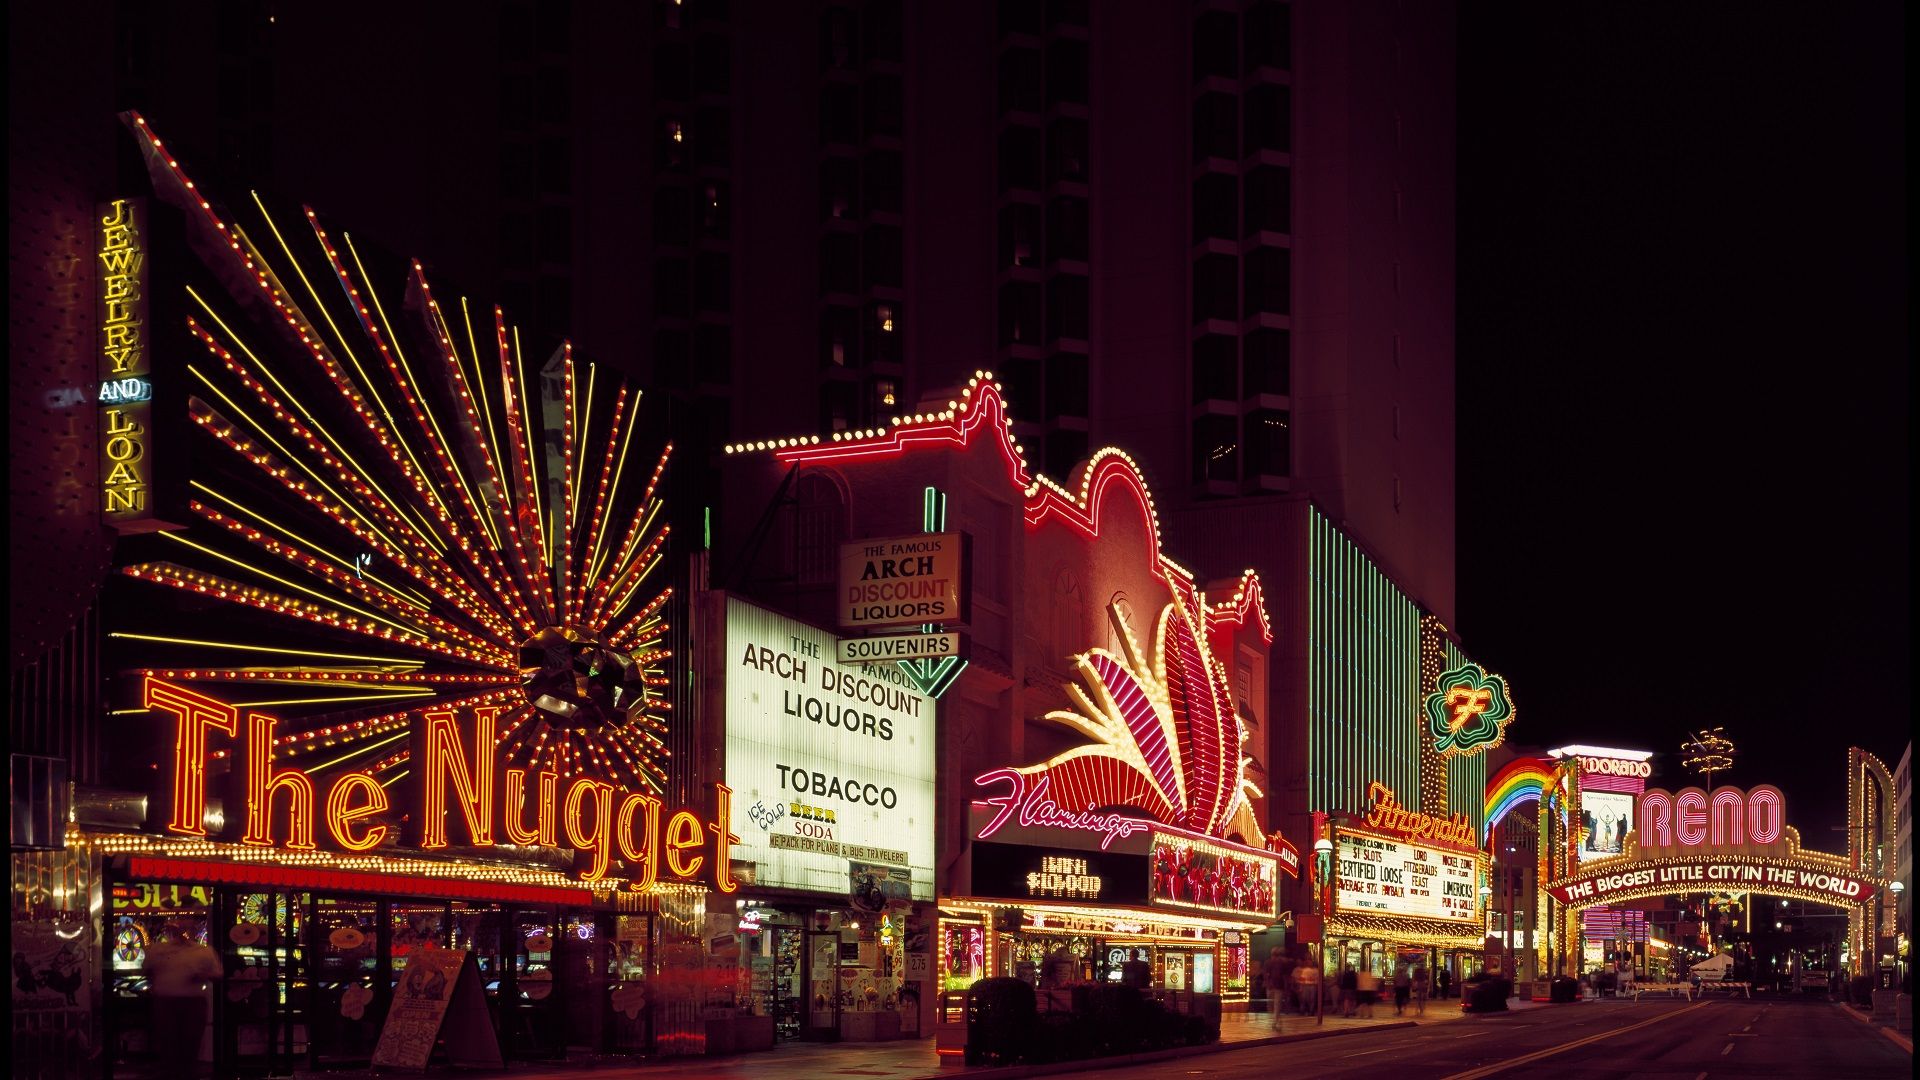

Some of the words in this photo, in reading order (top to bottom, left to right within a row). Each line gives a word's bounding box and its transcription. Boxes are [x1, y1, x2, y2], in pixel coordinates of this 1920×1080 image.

[99, 199, 134, 373] JEWELRY
[99, 378, 142, 401] AND
[106, 409, 138, 512] LOAN
[864, 546, 885, 557] THE
[891, 541, 942, 555] FAMOUS
[860, 555, 935, 581] ARCH
[849, 579, 949, 604] DISCOUNT
[852, 601, 945, 621] LIQUORS
[790, 636, 820, 660] THE
[847, 637, 950, 658] SOUVENIRS
[742, 643, 806, 684] ARCH
[821, 666, 922, 718] DISCOUNT
[784, 690, 893, 741] LIQUORS
[144, 677, 389, 850] The
[422, 706, 742, 894] Nugget
[776, 763, 897, 809] TOBACCO
[747, 801, 766, 824] ICE
[759, 803, 785, 831] COLD
[789, 802, 837, 825] BEER
[975, 769, 1148, 850] Flamingo
[1367, 781, 1476, 846] Fitzgeralds
[1640, 790, 1781, 848] RENO
[795, 821, 833, 841] SODA
[770, 834, 779, 847] WE
[782, 835, 799, 849] PACK
[801, 838, 815, 851] FOR
[816, 841, 838, 855] PLANE
[841, 845, 847, 855] &
[849, 847, 864, 857] BUS
[866, 848, 904, 863] TRAVELERS
[1281, 847, 1298, 868] ALLEY
[1353, 846, 1360, 859] $1
[1363, 849, 1382, 863] SLOTS
[1414, 849, 1427, 861] LORD
[1339, 859, 1376, 880] CERTIFIED
[1380, 866, 1403, 884] LOOSE
[1404, 861, 1437, 877] FITZGERALDS
[1339, 878, 1365, 893] AVERAGE
[1382, 884, 1405, 898] PAYBACK
[1412, 875, 1428, 888] FEAST
[1443, 881, 1472, 898] LIMERICKS
[1565, 883, 1593, 900] THE
[1596, 870, 1656, 893] BIGGEST
[1660, 865, 1703, 882] LITTLE
[1708, 864, 1742, 880] CITY
[1744, 865, 1763, 881] IN
[1766, 868, 1795, 885] THE
[1799, 870, 1860, 897] WORLD
[1442, 897, 1451, 908] PUB
[1064, 917, 1092, 930] LIVE
[1148, 922, 1171, 936] LIVE
